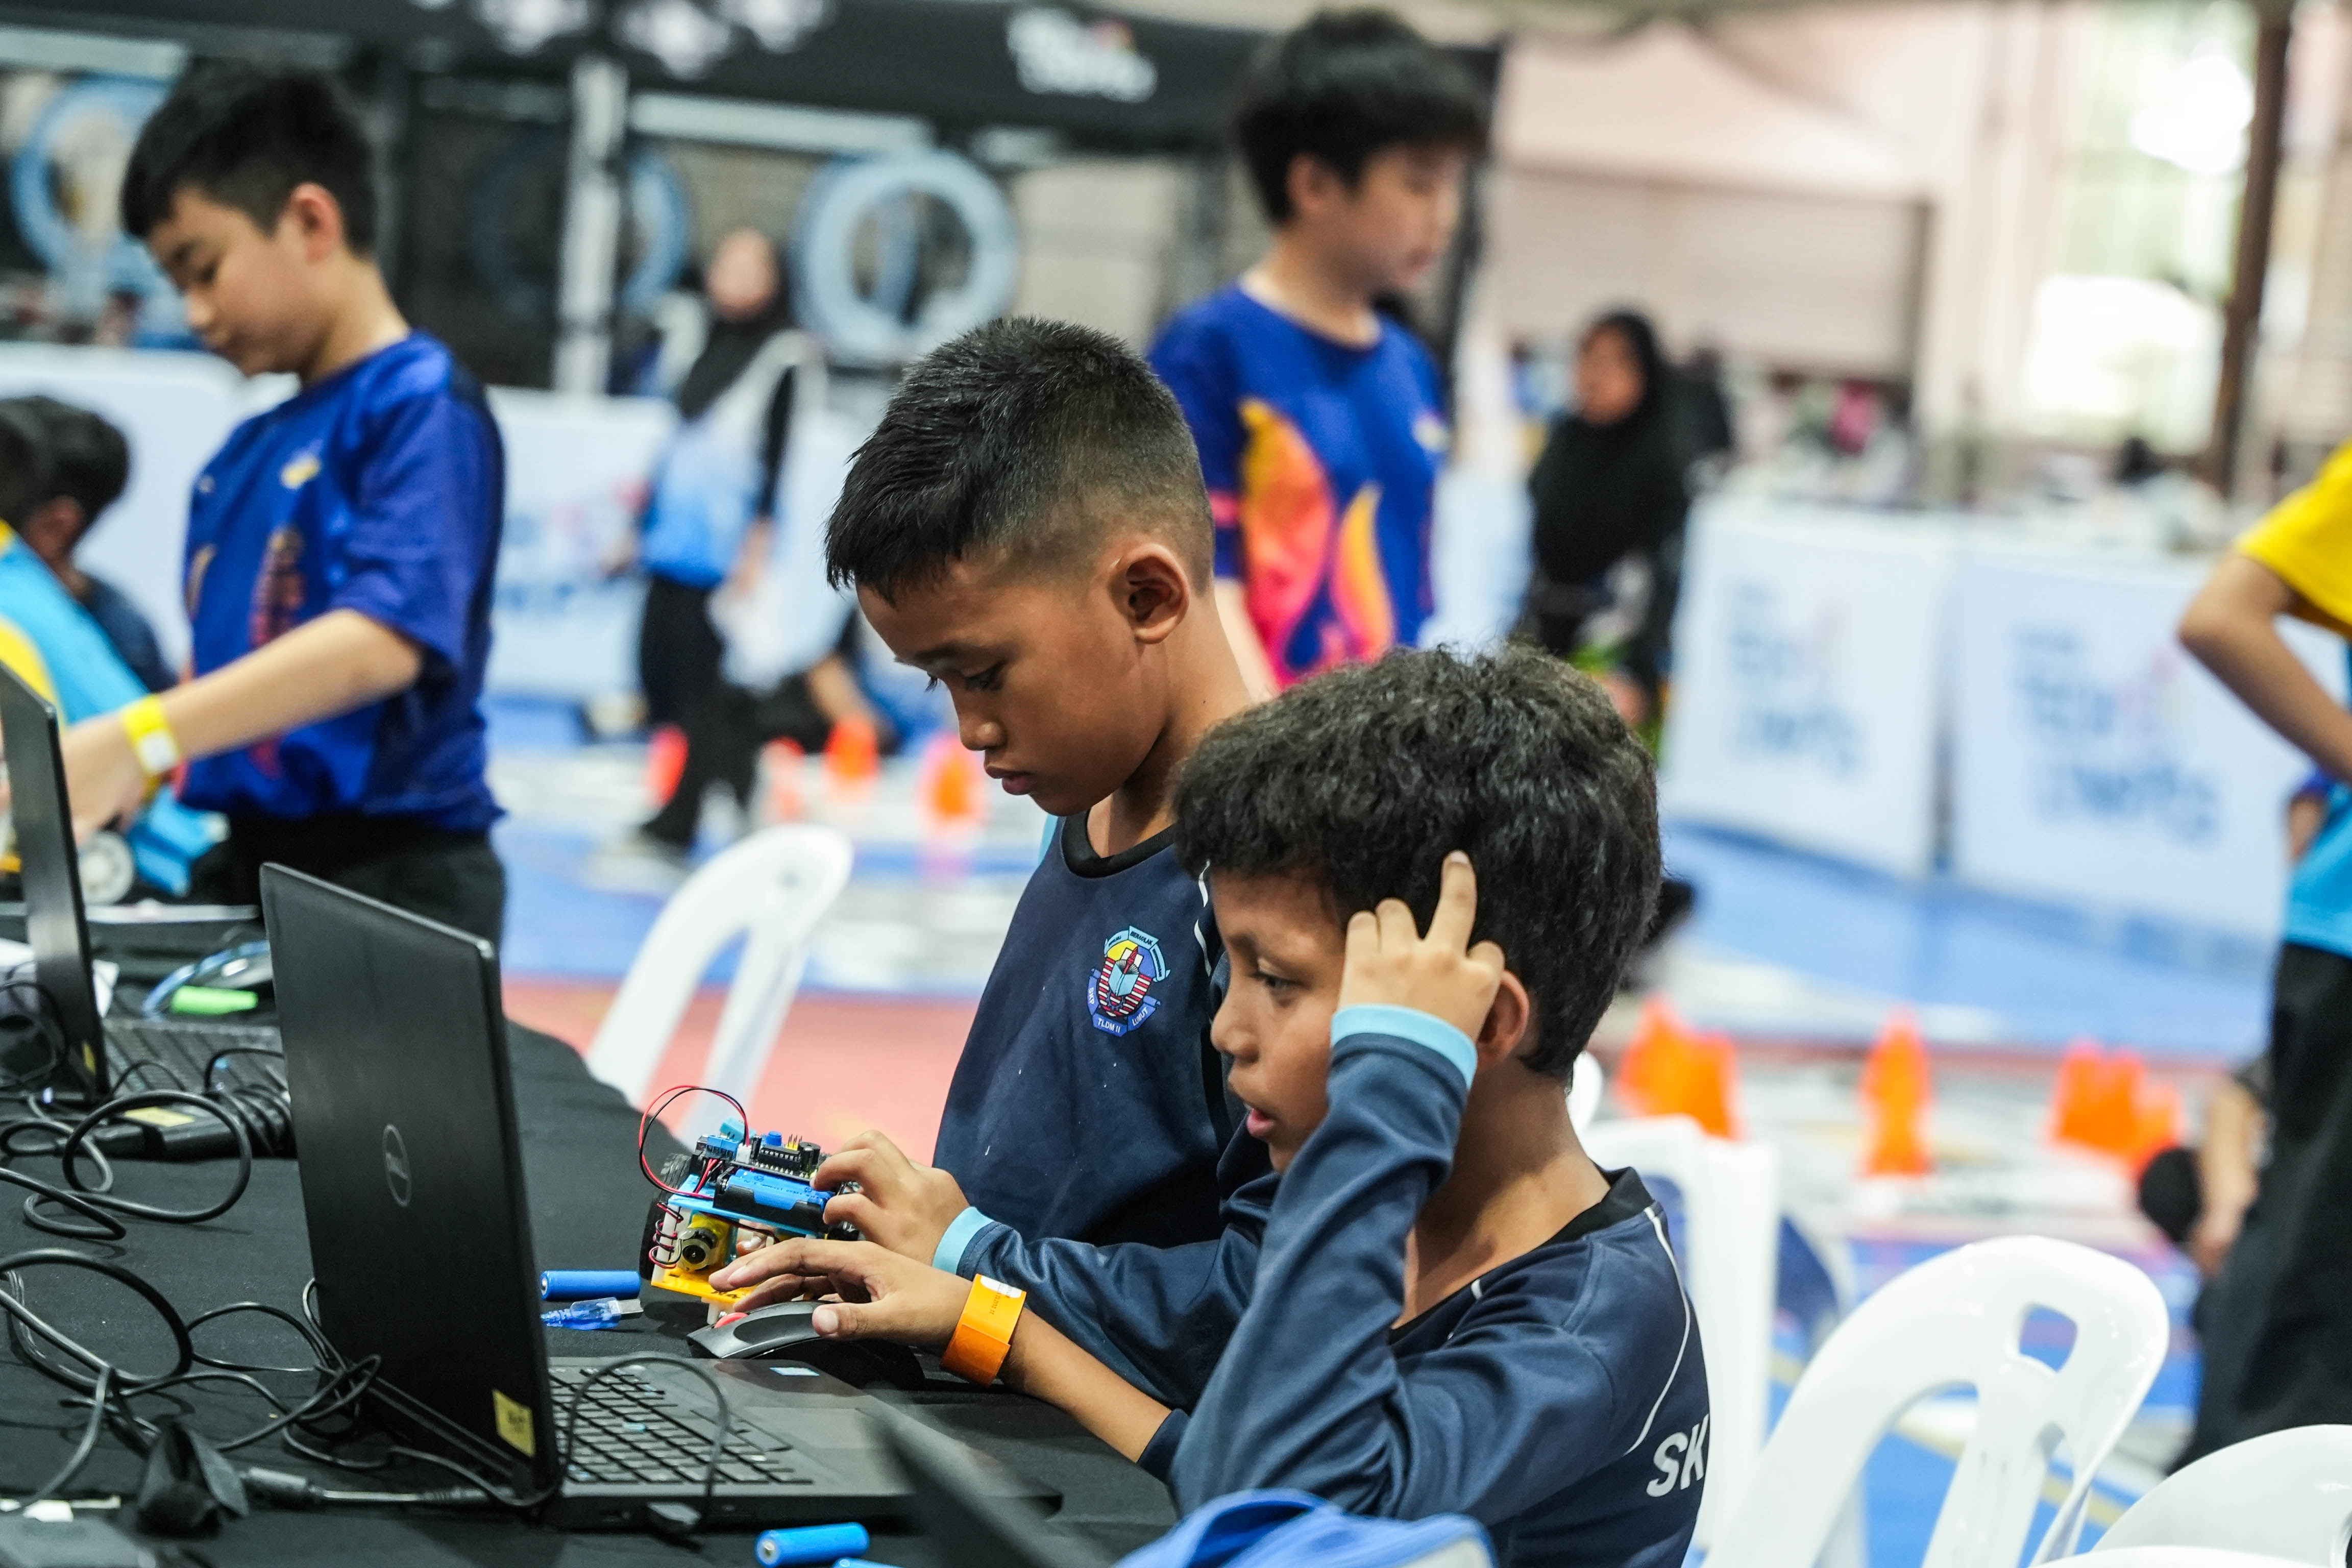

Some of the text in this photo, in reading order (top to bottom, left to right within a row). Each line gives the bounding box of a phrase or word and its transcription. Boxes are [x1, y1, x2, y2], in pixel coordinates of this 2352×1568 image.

[1098, 1018, 1115, 1031] TLDM
[1132, 1007, 1148, 1026] LUMUT
[1646, 1413, 1709, 1497] SK
